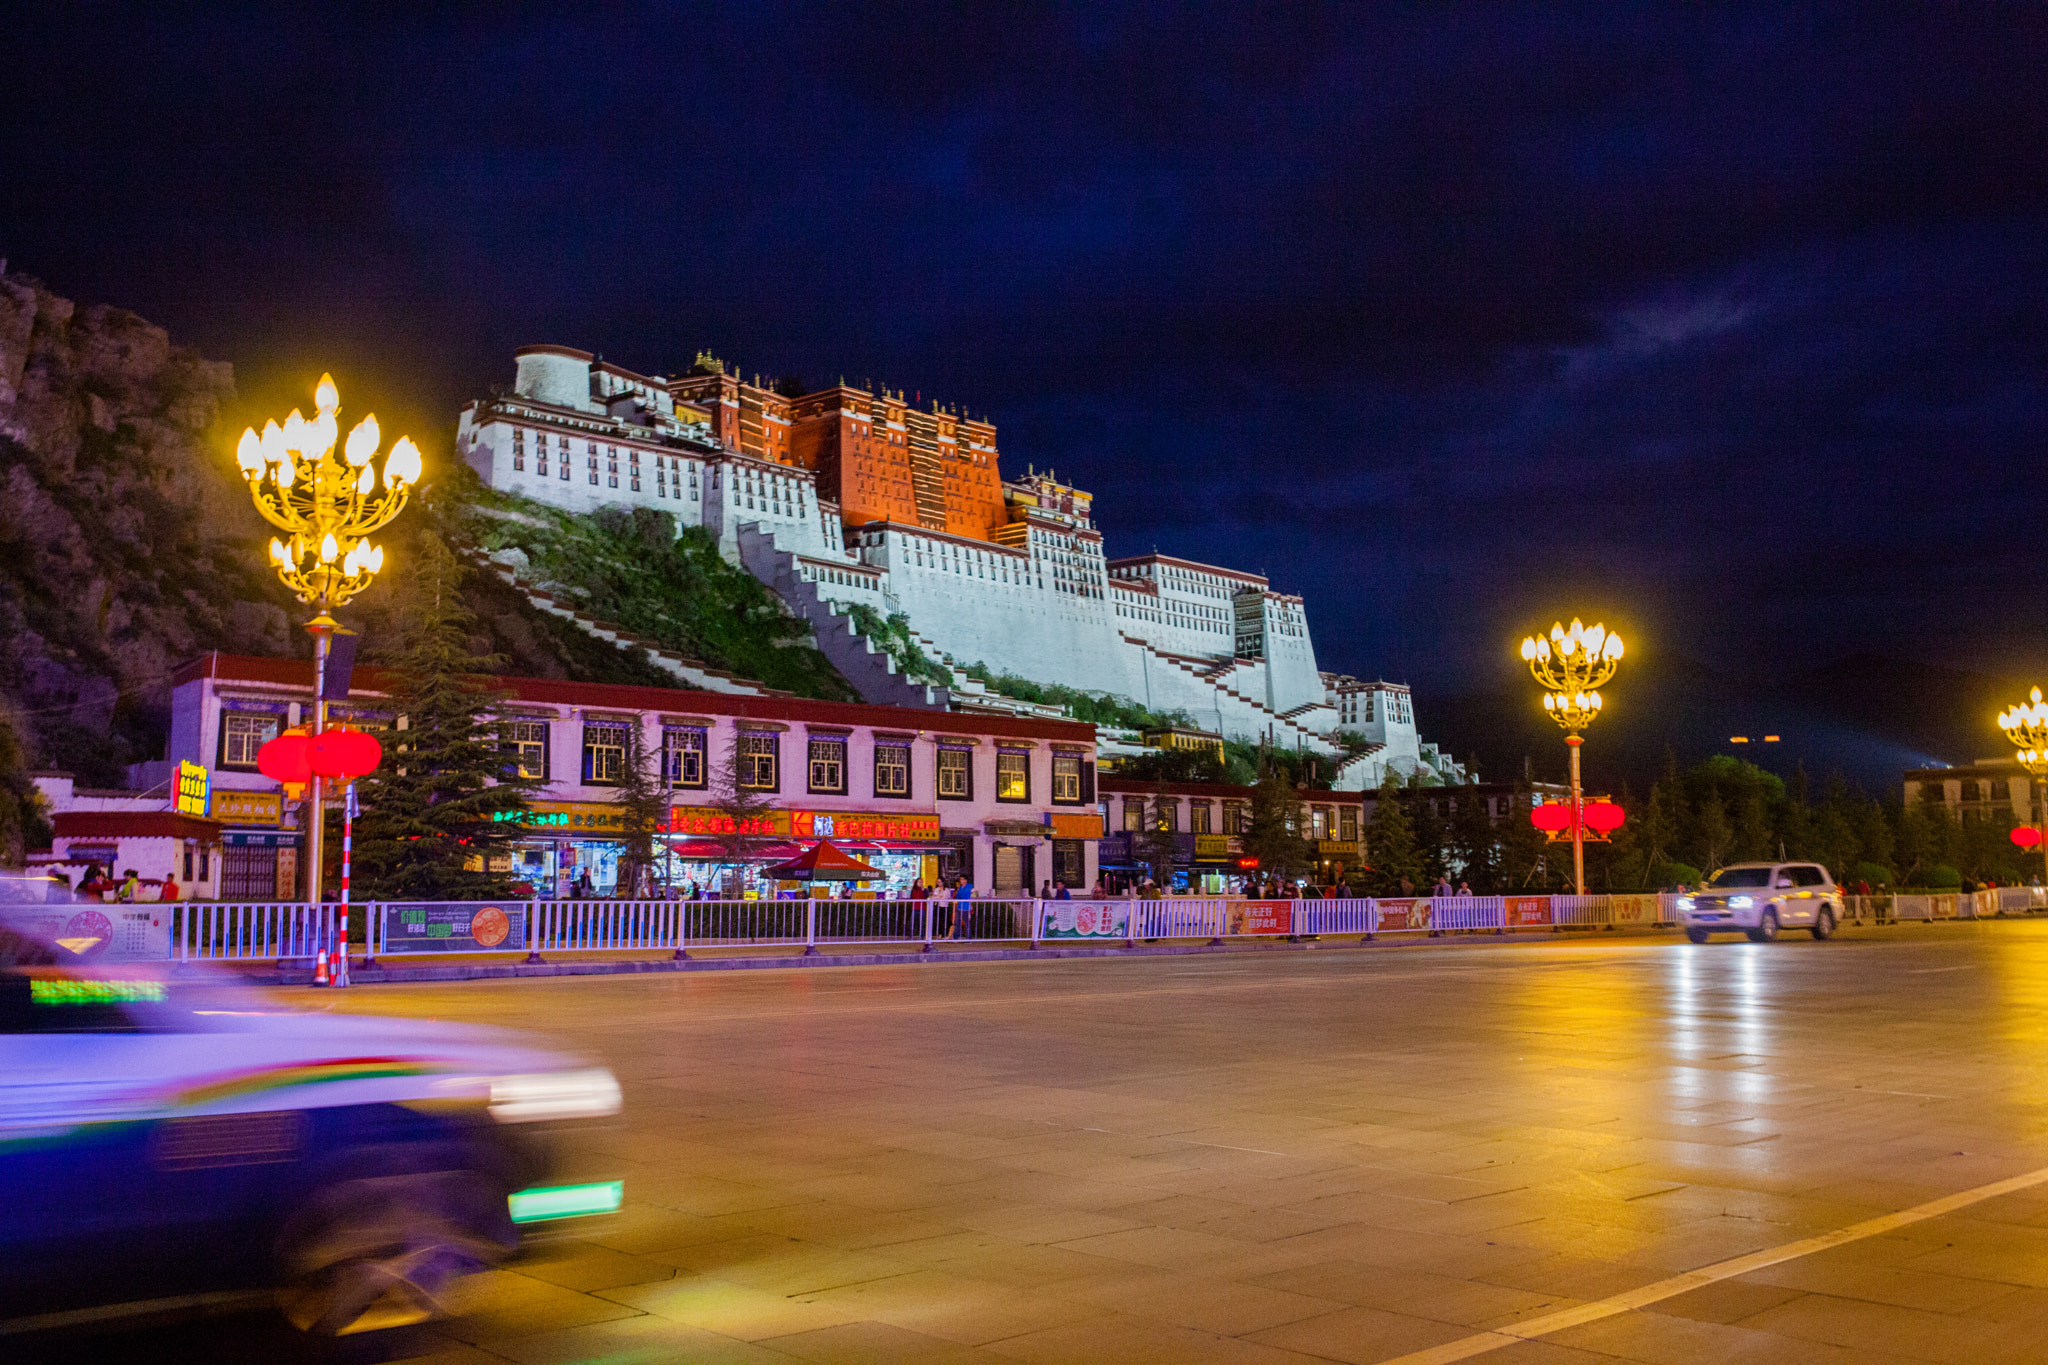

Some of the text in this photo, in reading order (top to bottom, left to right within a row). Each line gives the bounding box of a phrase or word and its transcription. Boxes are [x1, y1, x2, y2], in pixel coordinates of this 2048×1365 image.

[401, 910, 426, 924] 价值观
[1245, 907, 1272, 917] 春光正好
[427, 923, 453, 937] 中国梦
[453, 922, 471, 933] 好日子
[1249, 918, 1277, 929] 圆梦此时
